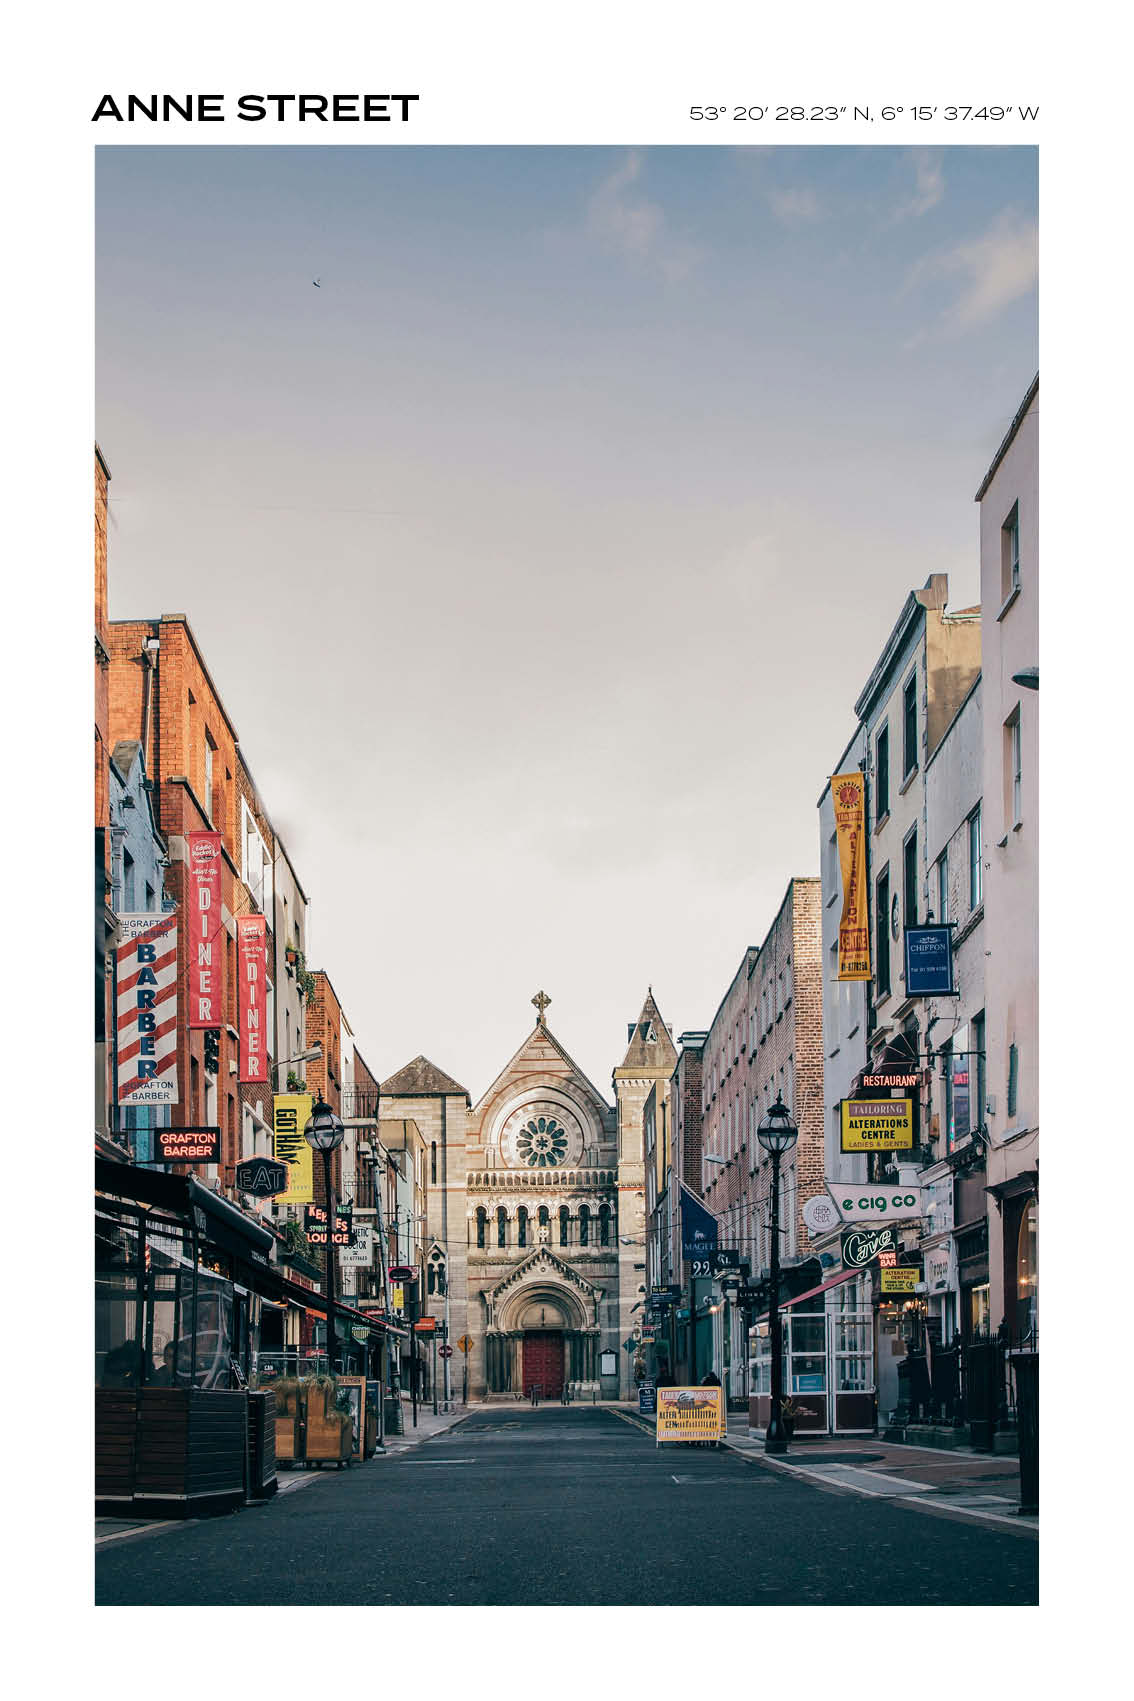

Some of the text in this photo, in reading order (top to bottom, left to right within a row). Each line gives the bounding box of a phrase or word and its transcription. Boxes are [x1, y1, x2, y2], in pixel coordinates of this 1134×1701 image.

[130, 920, 173, 928] GRAFTON
[131, 930, 168, 938] BARBER
[910, 944, 946, 952] CHIFFON
[198, 887, 213, 1021] DINER
[136, 943, 159, 1079] BARBER
[246, 962, 260, 1077] DINER
[131, 1081, 174, 1089] GRAFTON
[863, 1075, 917, 1087] RESTAURANT
[132, 1092, 170, 1100] BARBER
[854, 1104, 902, 1114] TAILORING
[849, 1119, 908, 1129] ALTERATIONS
[160, 1133, 216, 1144] GRAFTON
[862, 1130, 895, 1139] CENTRE
[163, 1146, 212, 1156] BARBER
[240, 1166, 283, 1190] EAT
[842, 1194, 916, 1212] e cig co
[877, 1252, 896, 1260] WINE
[880, 1259, 896, 1267] BAR
[693, 1261, 712, 1276] 22
